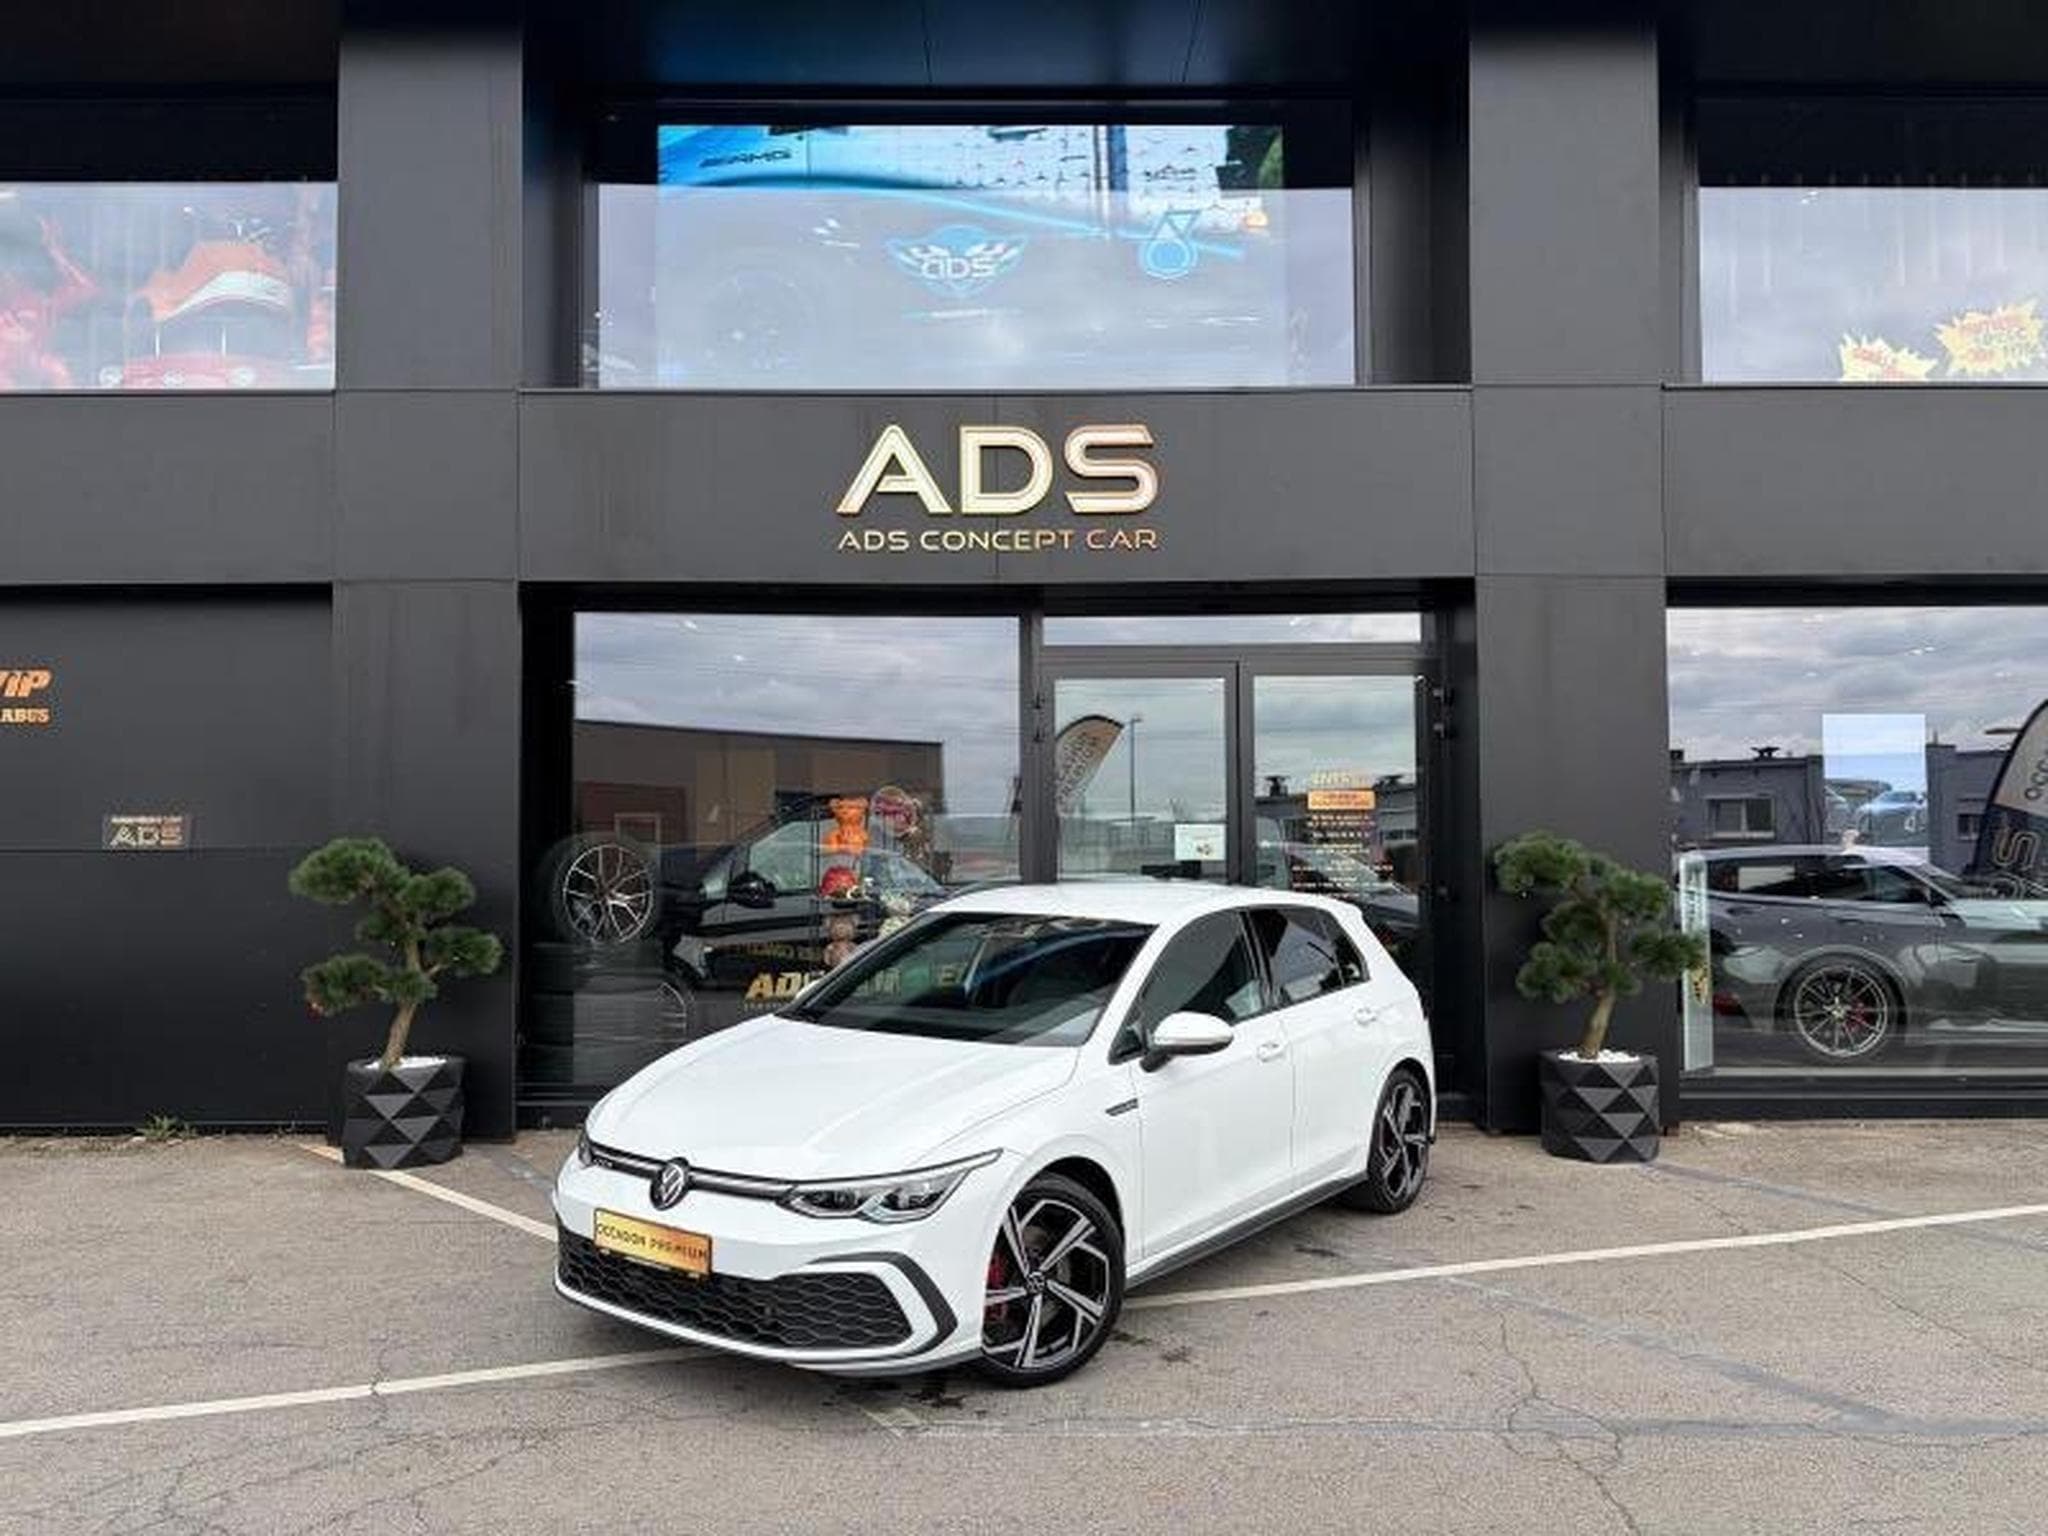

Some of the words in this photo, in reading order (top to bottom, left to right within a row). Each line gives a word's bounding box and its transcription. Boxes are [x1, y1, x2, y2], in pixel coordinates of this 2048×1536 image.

[836, 424, 1158, 515] ADS
[837, 530, 910, 550] ADS
[919, 530, 1075, 550] CONCEPT
[1085, 529, 1158, 549] CAR
